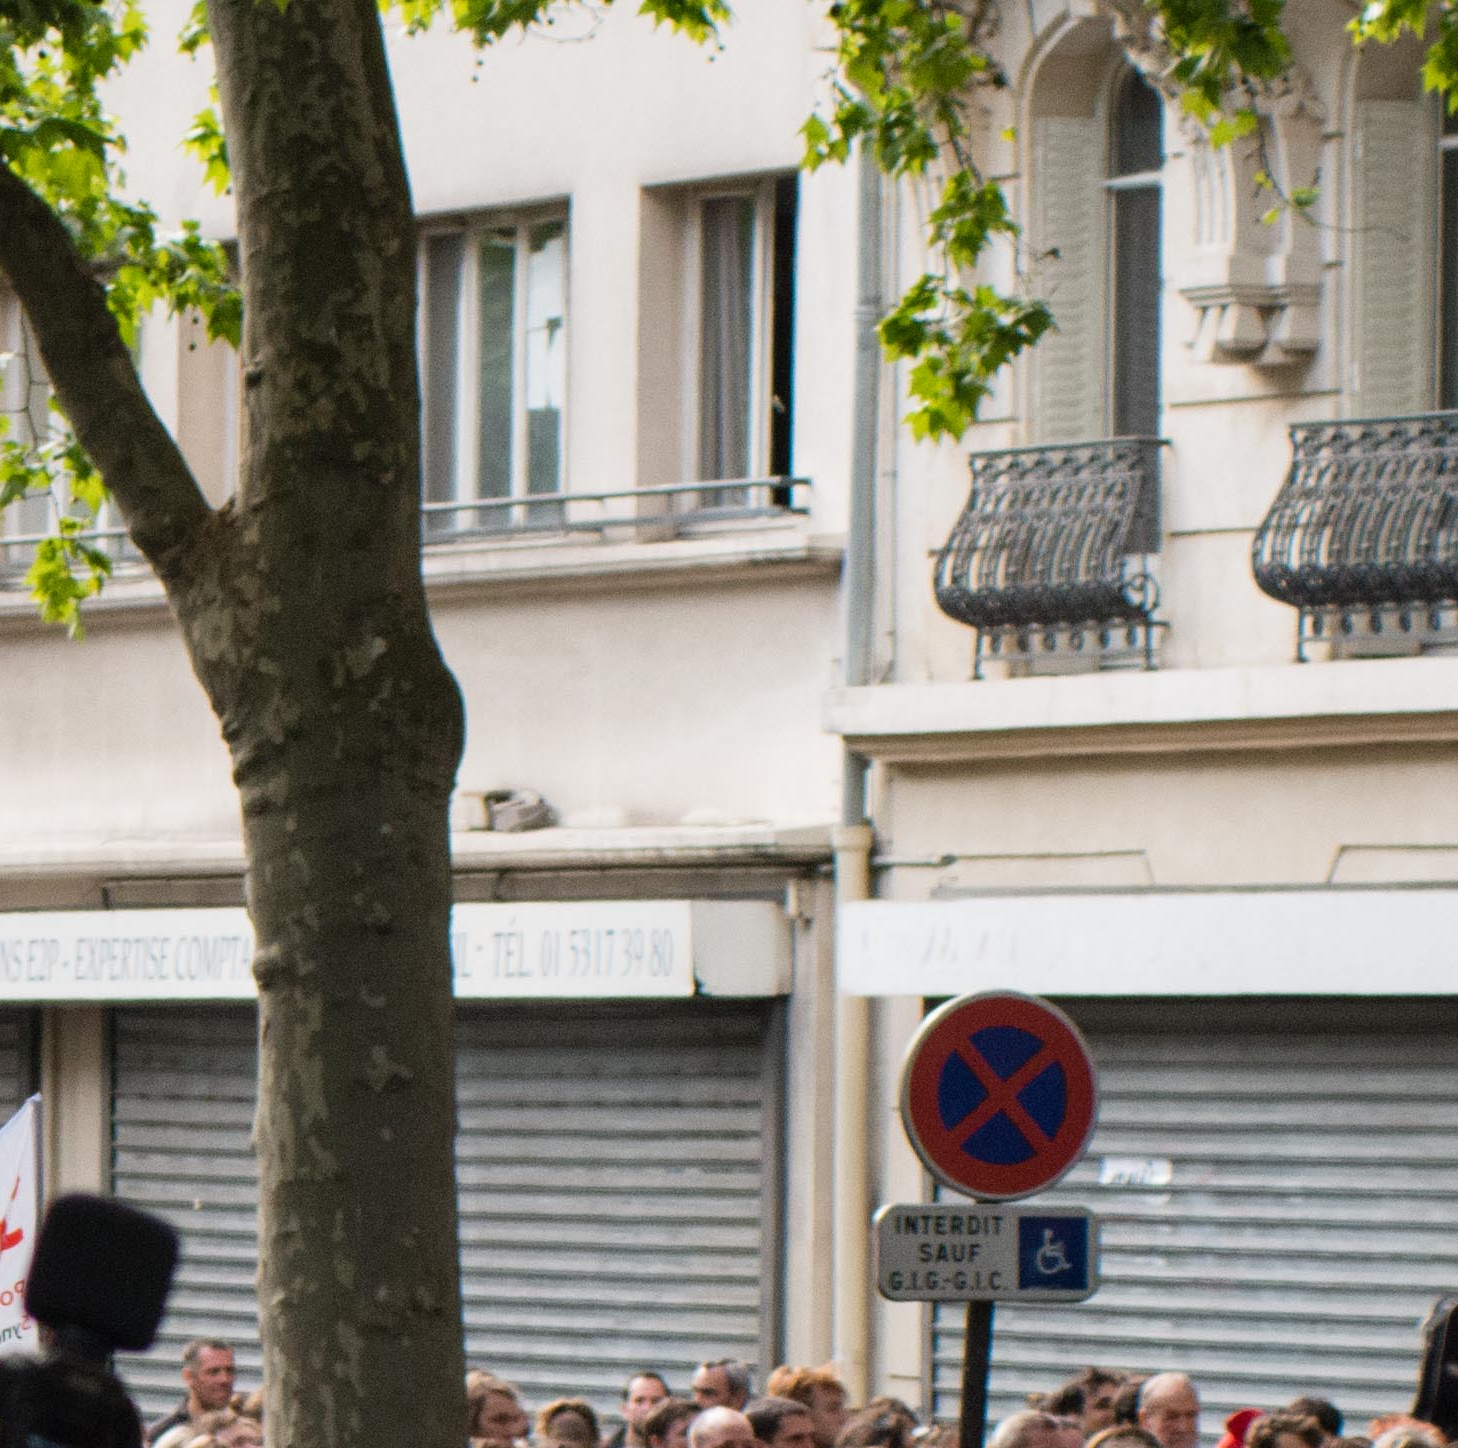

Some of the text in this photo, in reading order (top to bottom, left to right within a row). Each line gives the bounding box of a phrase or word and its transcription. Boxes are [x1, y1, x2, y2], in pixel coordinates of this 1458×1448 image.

[75, 936, 171, 981] EXPERTISE
[541, 929, 561, 978] 01
[894, 1215, 1004, 1236] INTERDIT
[918, 1243, 982, 1263] SAUF
